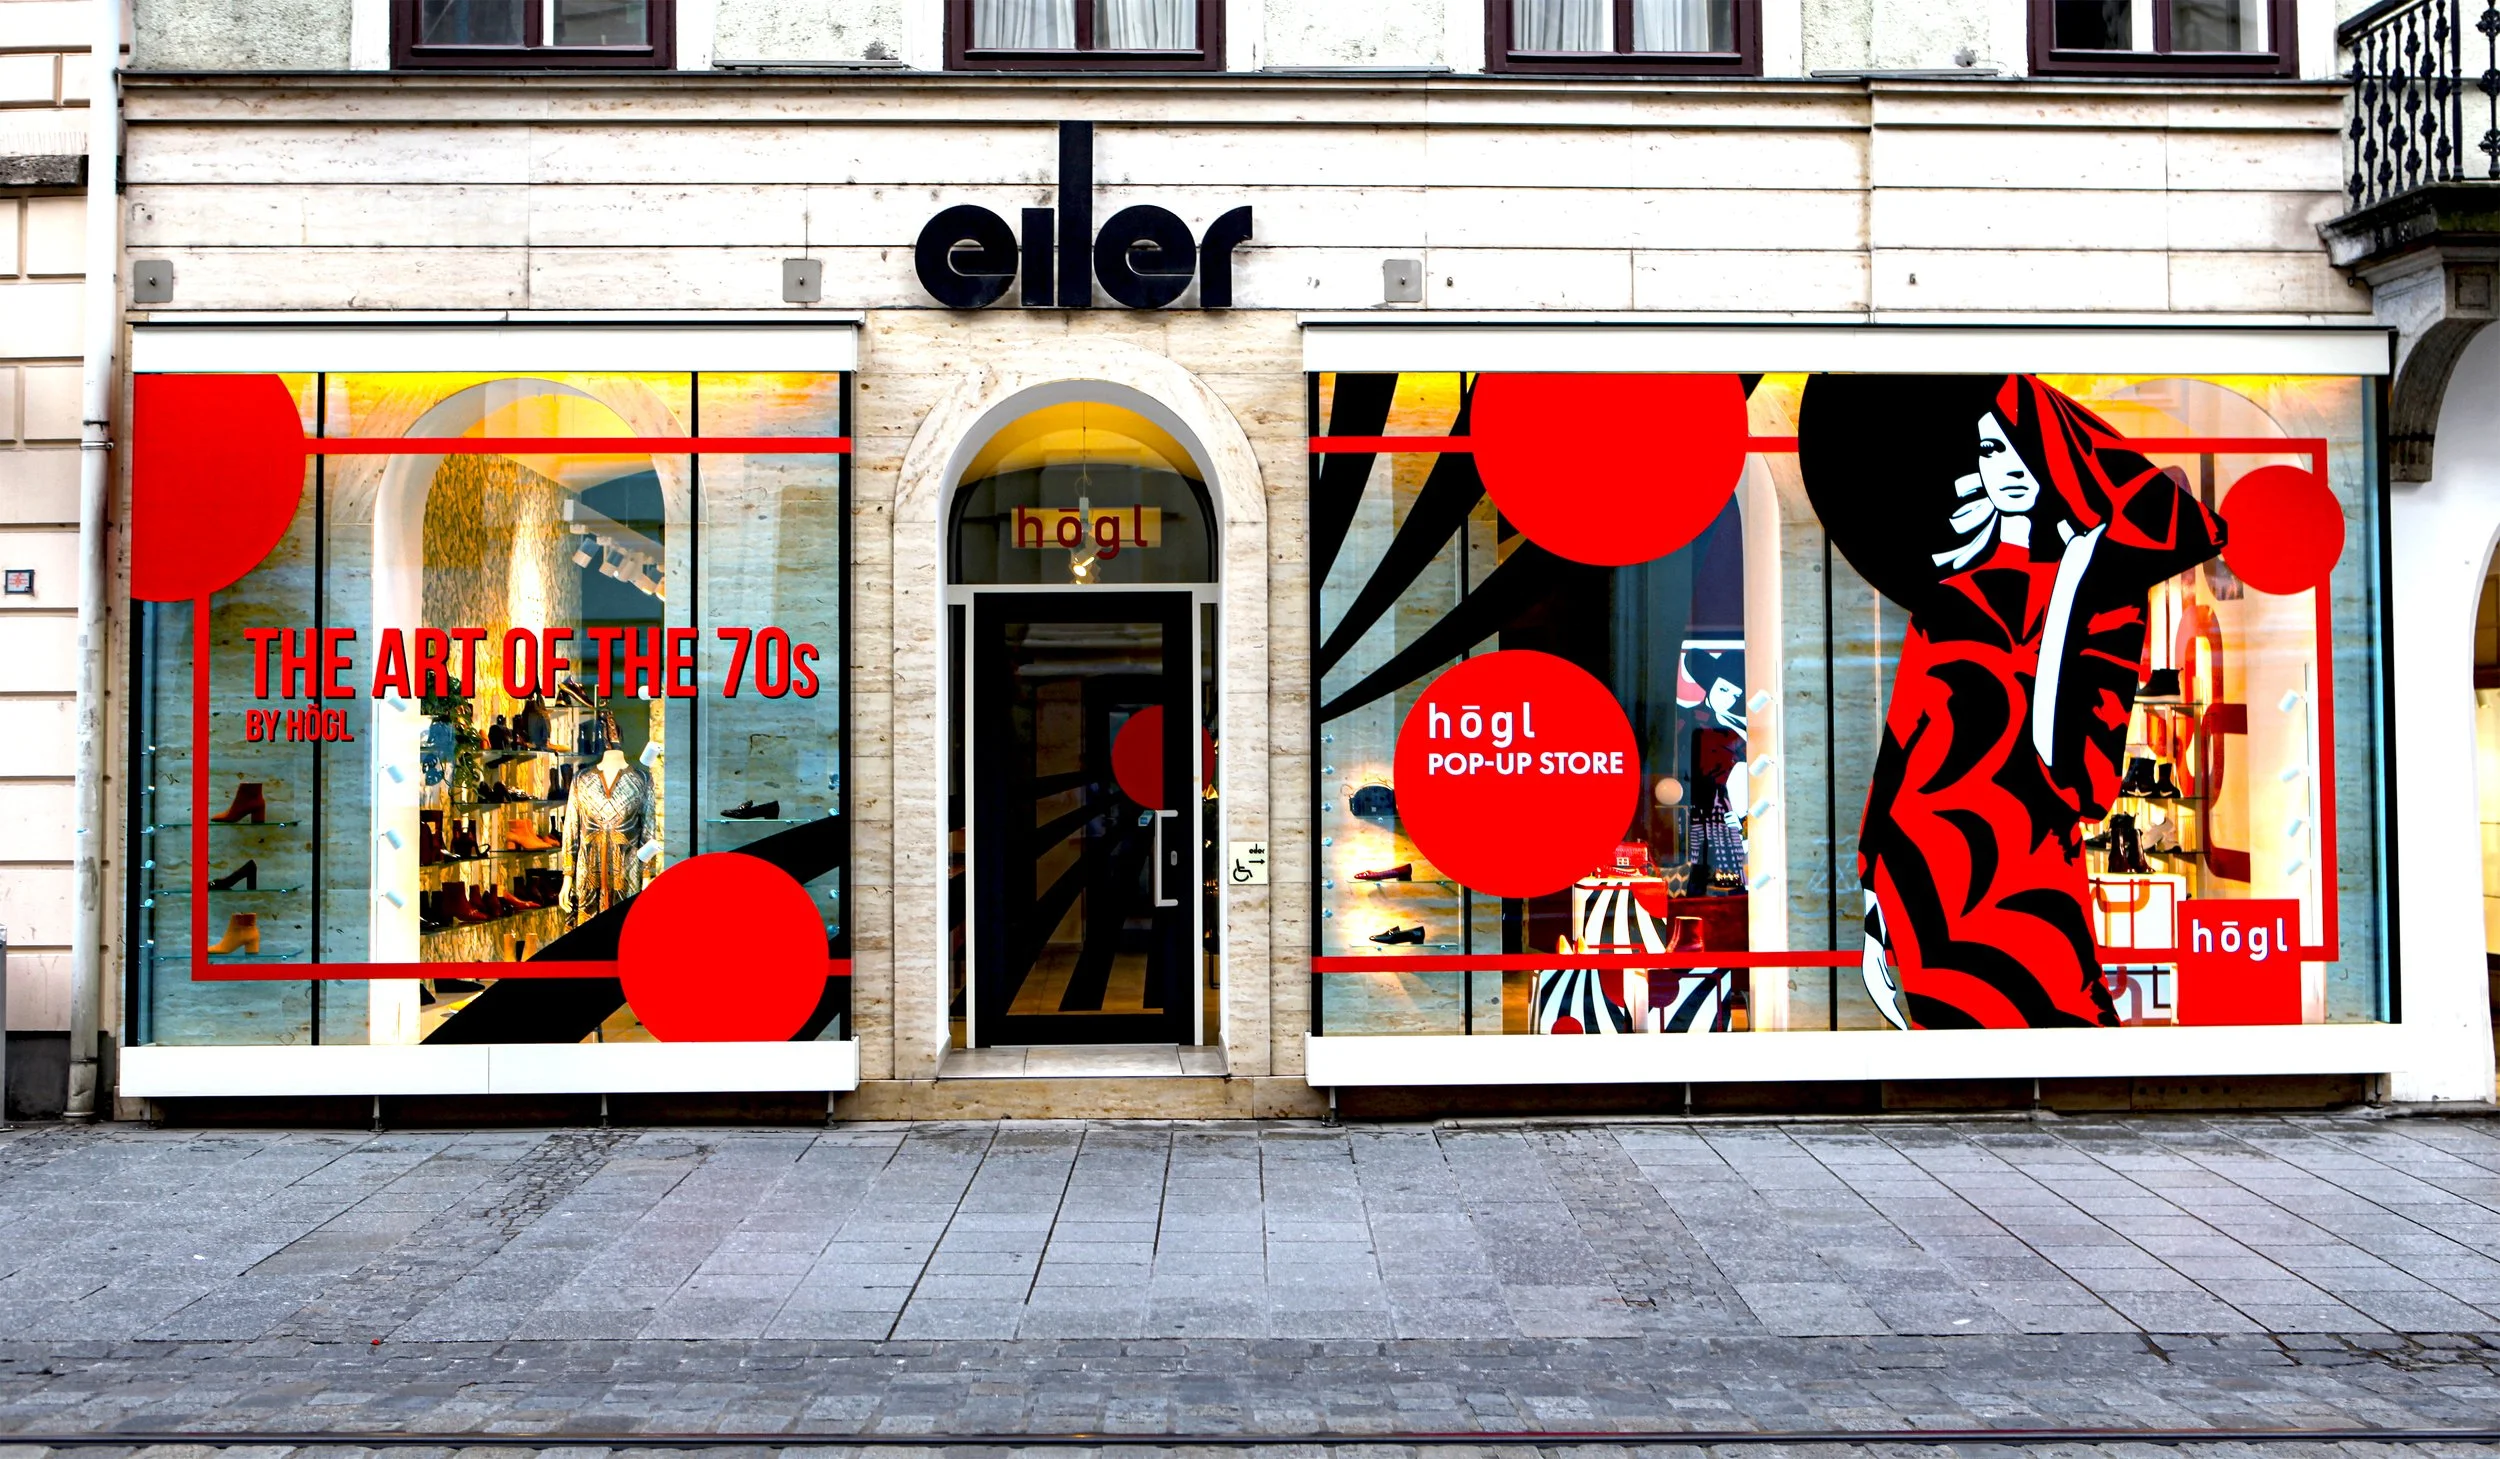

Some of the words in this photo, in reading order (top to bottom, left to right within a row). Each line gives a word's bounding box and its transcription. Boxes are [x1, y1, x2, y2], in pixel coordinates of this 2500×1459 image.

[915, 120, 1252, 309] eiler
[244, 627, 356, 699] THE
[372, 627, 488, 699] ART
[502, 627, 574, 699] OF
[587, 627, 699, 699] THE
[717, 626, 819, 699] 70s
[245, 709, 281, 743] BY
[286, 703, 354, 743] HÖGL
[1428, 752, 1533, 776] POP-UP
[1539, 751, 1624, 775] STORE
